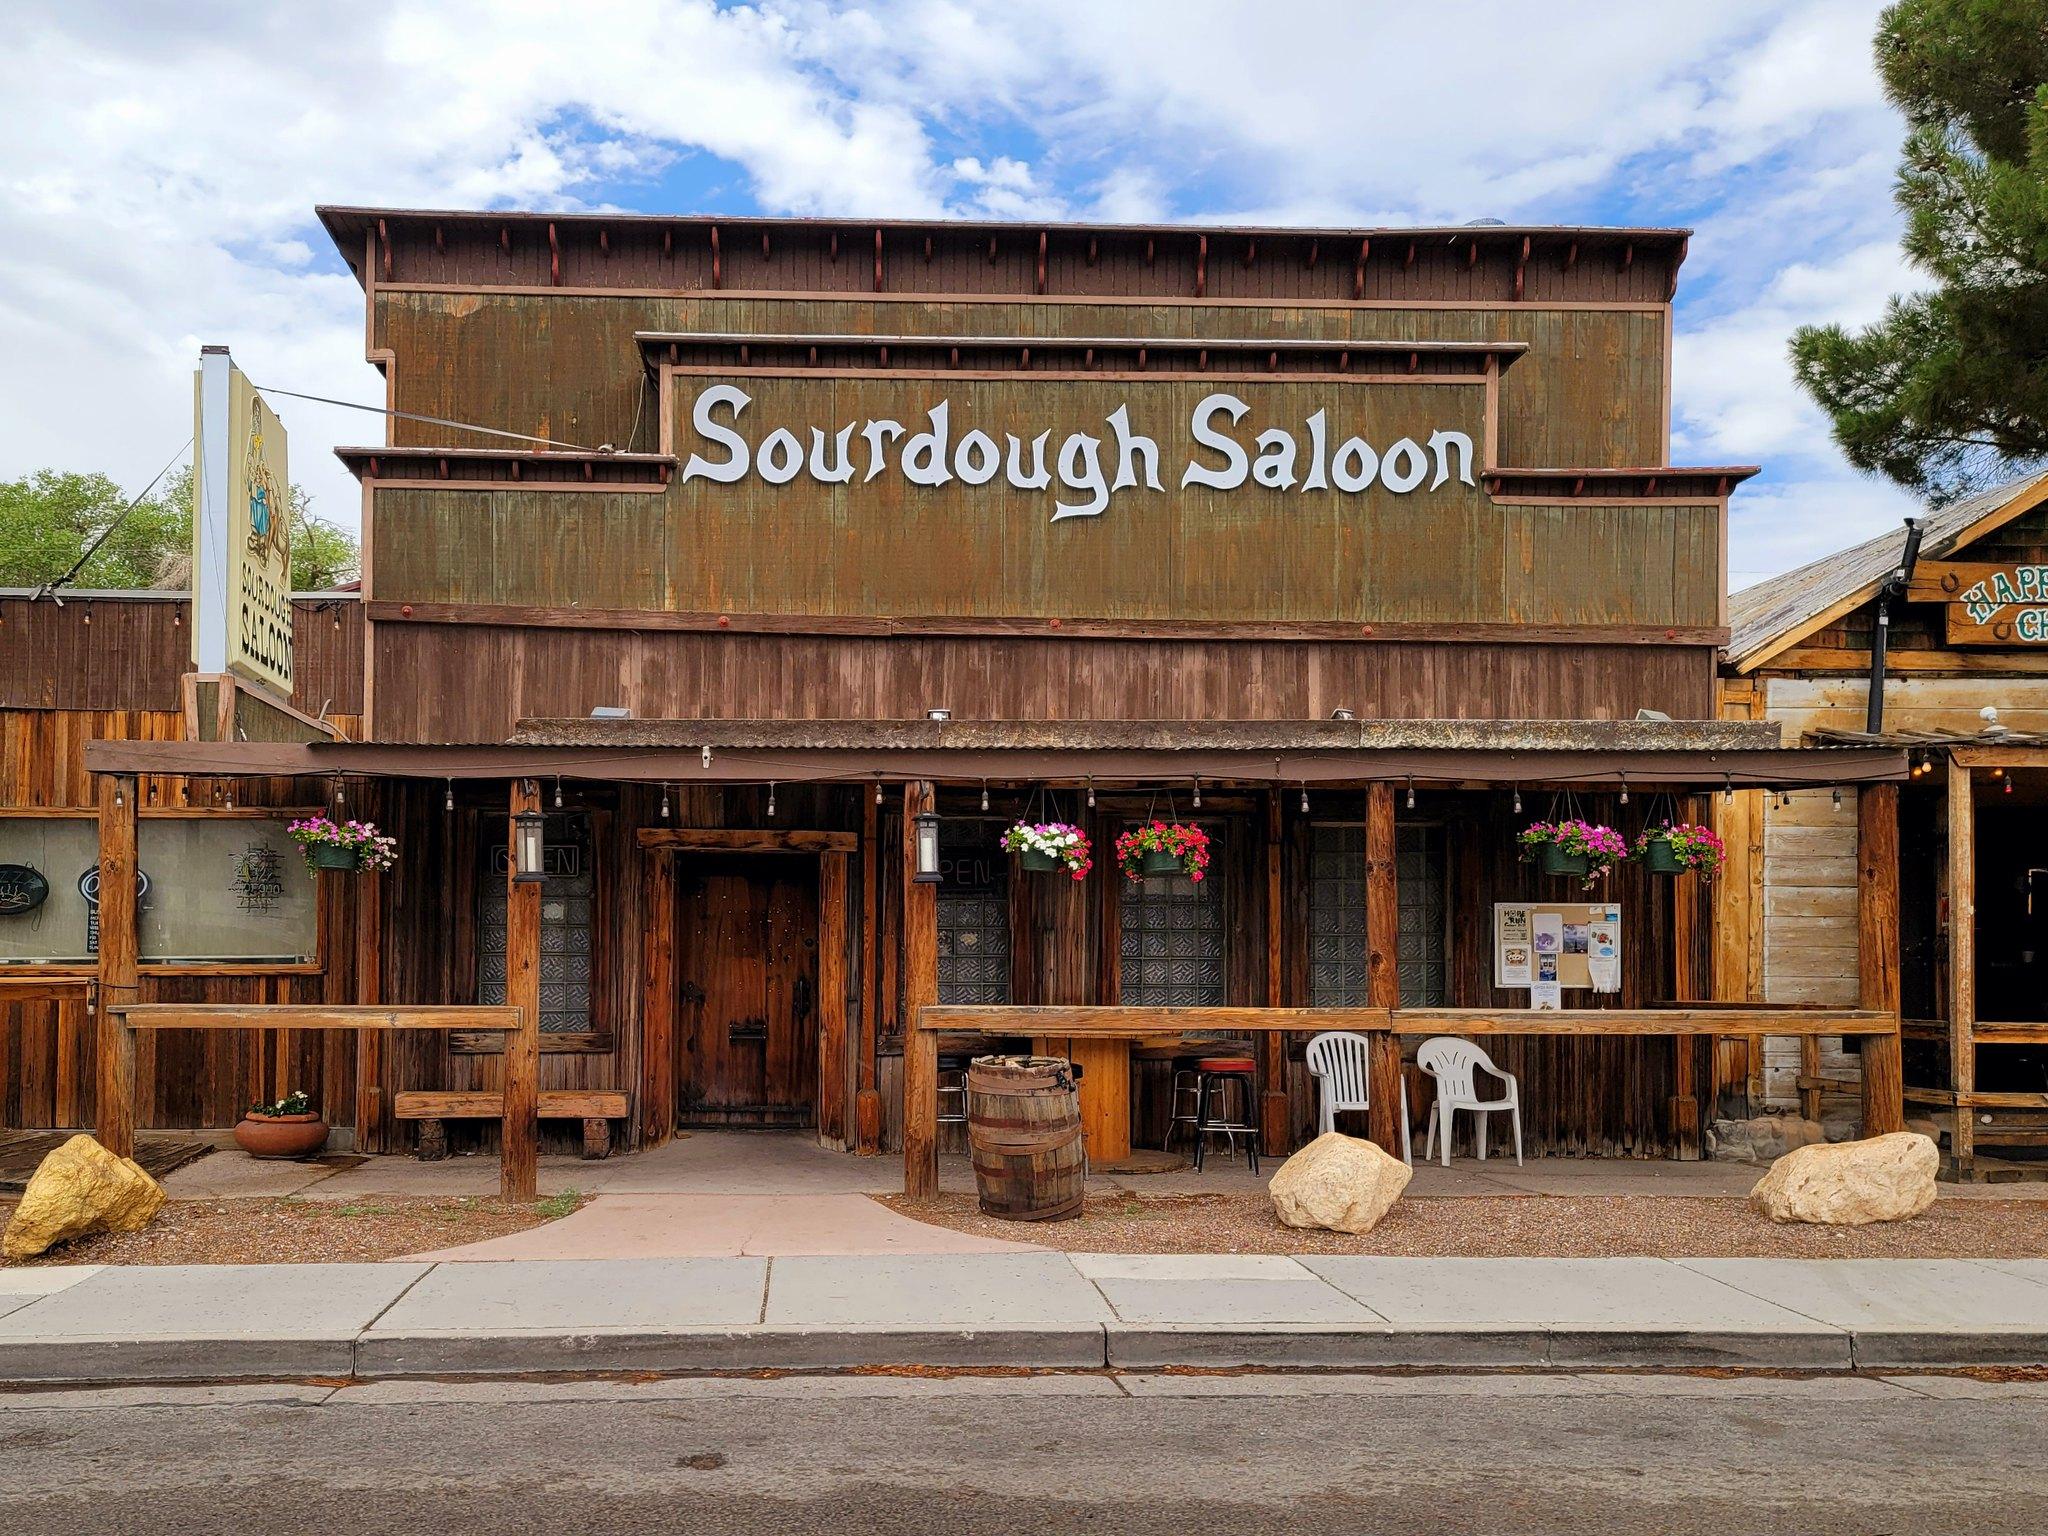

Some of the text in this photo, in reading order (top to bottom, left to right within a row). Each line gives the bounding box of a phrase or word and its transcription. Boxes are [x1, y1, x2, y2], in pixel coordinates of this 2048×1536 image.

[683, 385, 1476, 523] Sourdough Saloon
[241, 602, 292, 683] SALOON
